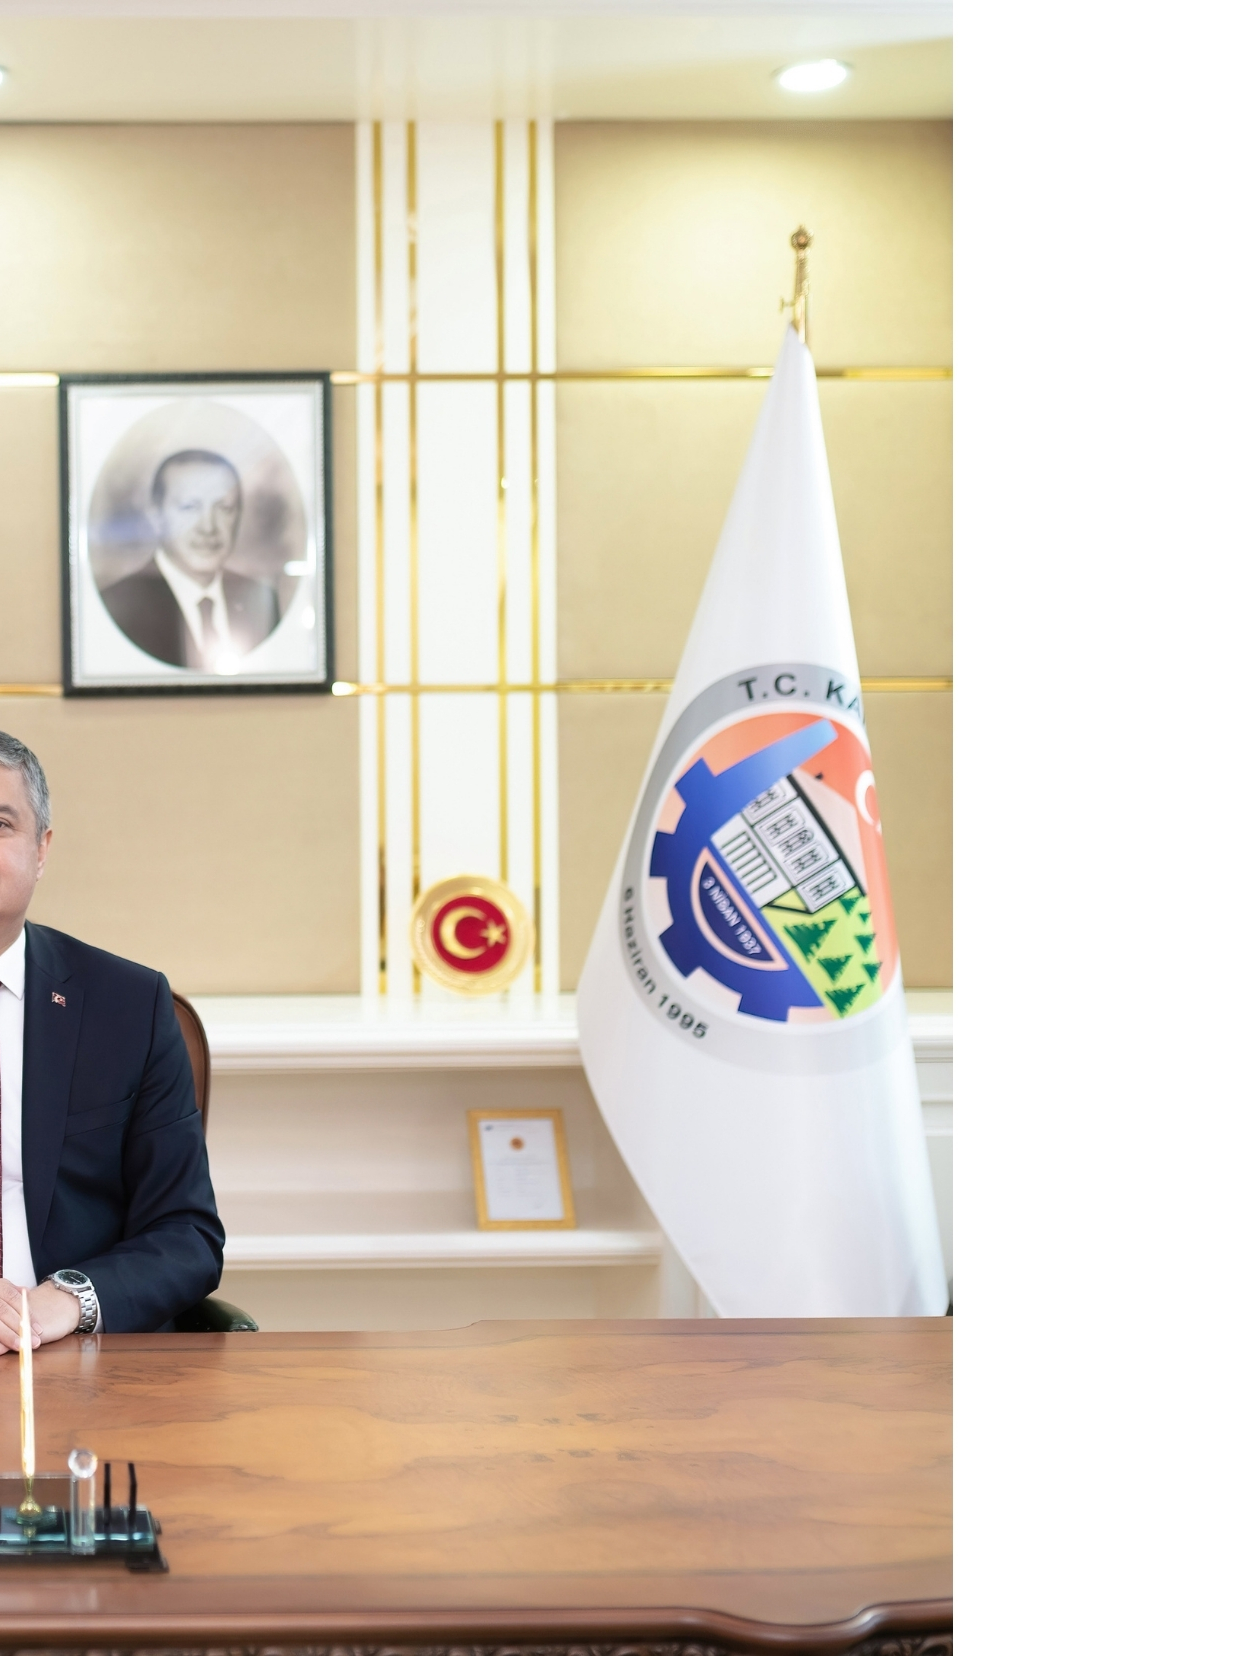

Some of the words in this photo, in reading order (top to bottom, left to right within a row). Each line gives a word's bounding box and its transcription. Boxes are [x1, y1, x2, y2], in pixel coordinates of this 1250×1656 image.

[737, 674, 812, 701] T.C.
[826, 679, 864, 723] KA
[702, 876, 715, 889] 3
[734, 924, 762, 954] 1937
[624, 906, 657, 995] Haziran
[658, 993, 708, 1039] 1995
